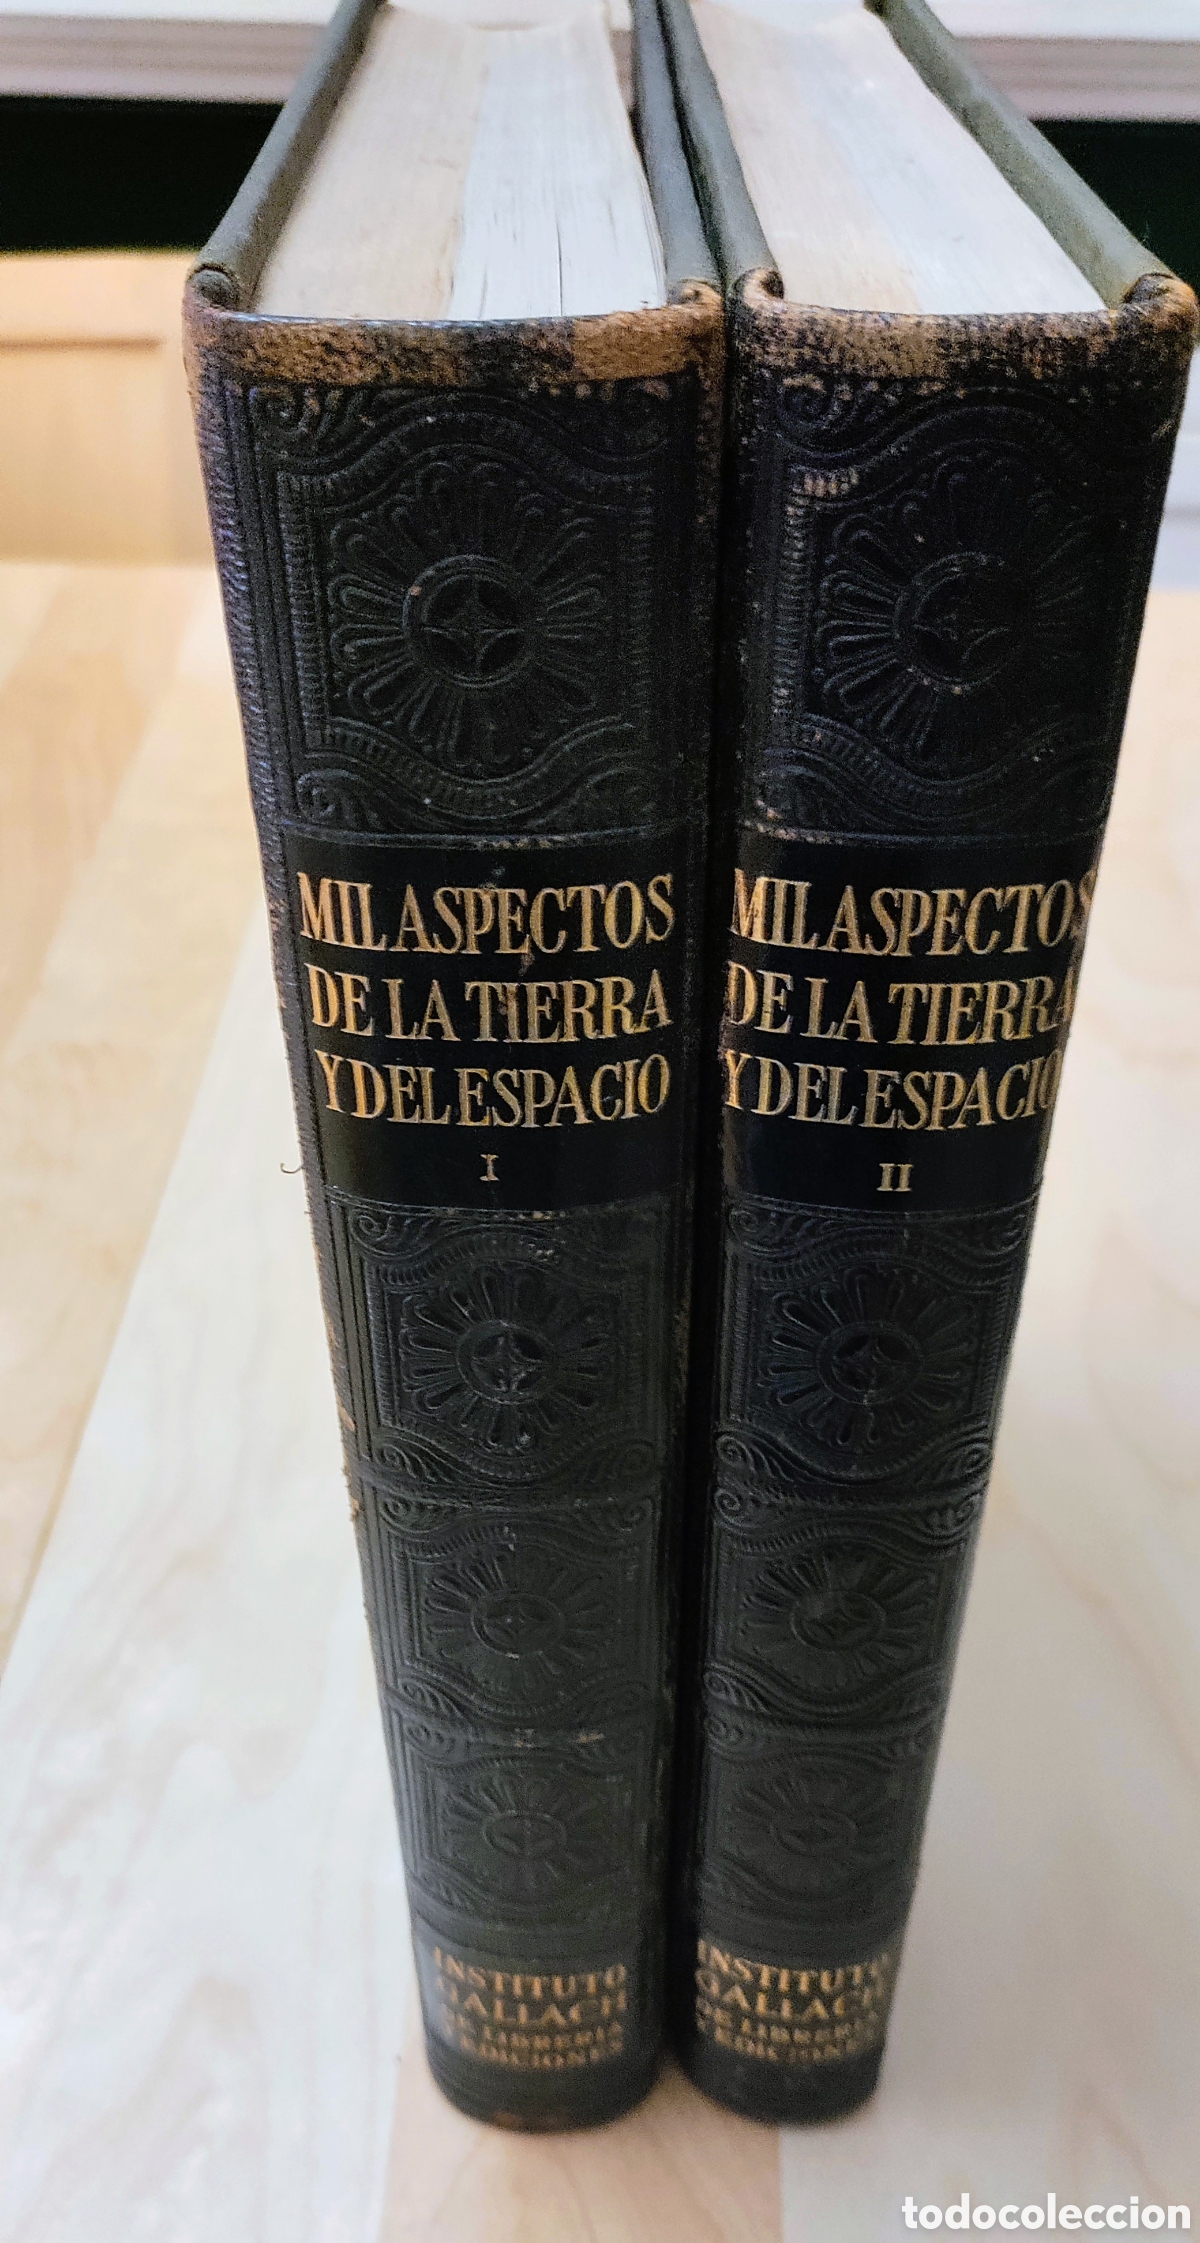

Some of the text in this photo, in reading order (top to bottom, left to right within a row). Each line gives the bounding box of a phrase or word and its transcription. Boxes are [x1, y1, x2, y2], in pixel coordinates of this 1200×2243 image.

[297, 872, 676, 954] MIL ASPECTOS
[729, 867, 1099, 956] MIL ASPECTOS
[304, 962, 674, 1043] DE LA TIERRA
[727, 960, 1076, 1045] DE LA TIERRA
[314, 1049, 672, 1128] Y DEL ESPACIO
[724, 1048, 1064, 1130] Y DEL ESPACIO
[479, 1153, 500, 1182] I
[876, 1162, 914, 1192] II
[434, 1946, 628, 2000] INSTITUTO
[697, 1938, 890, 1995] INSTITUTO
